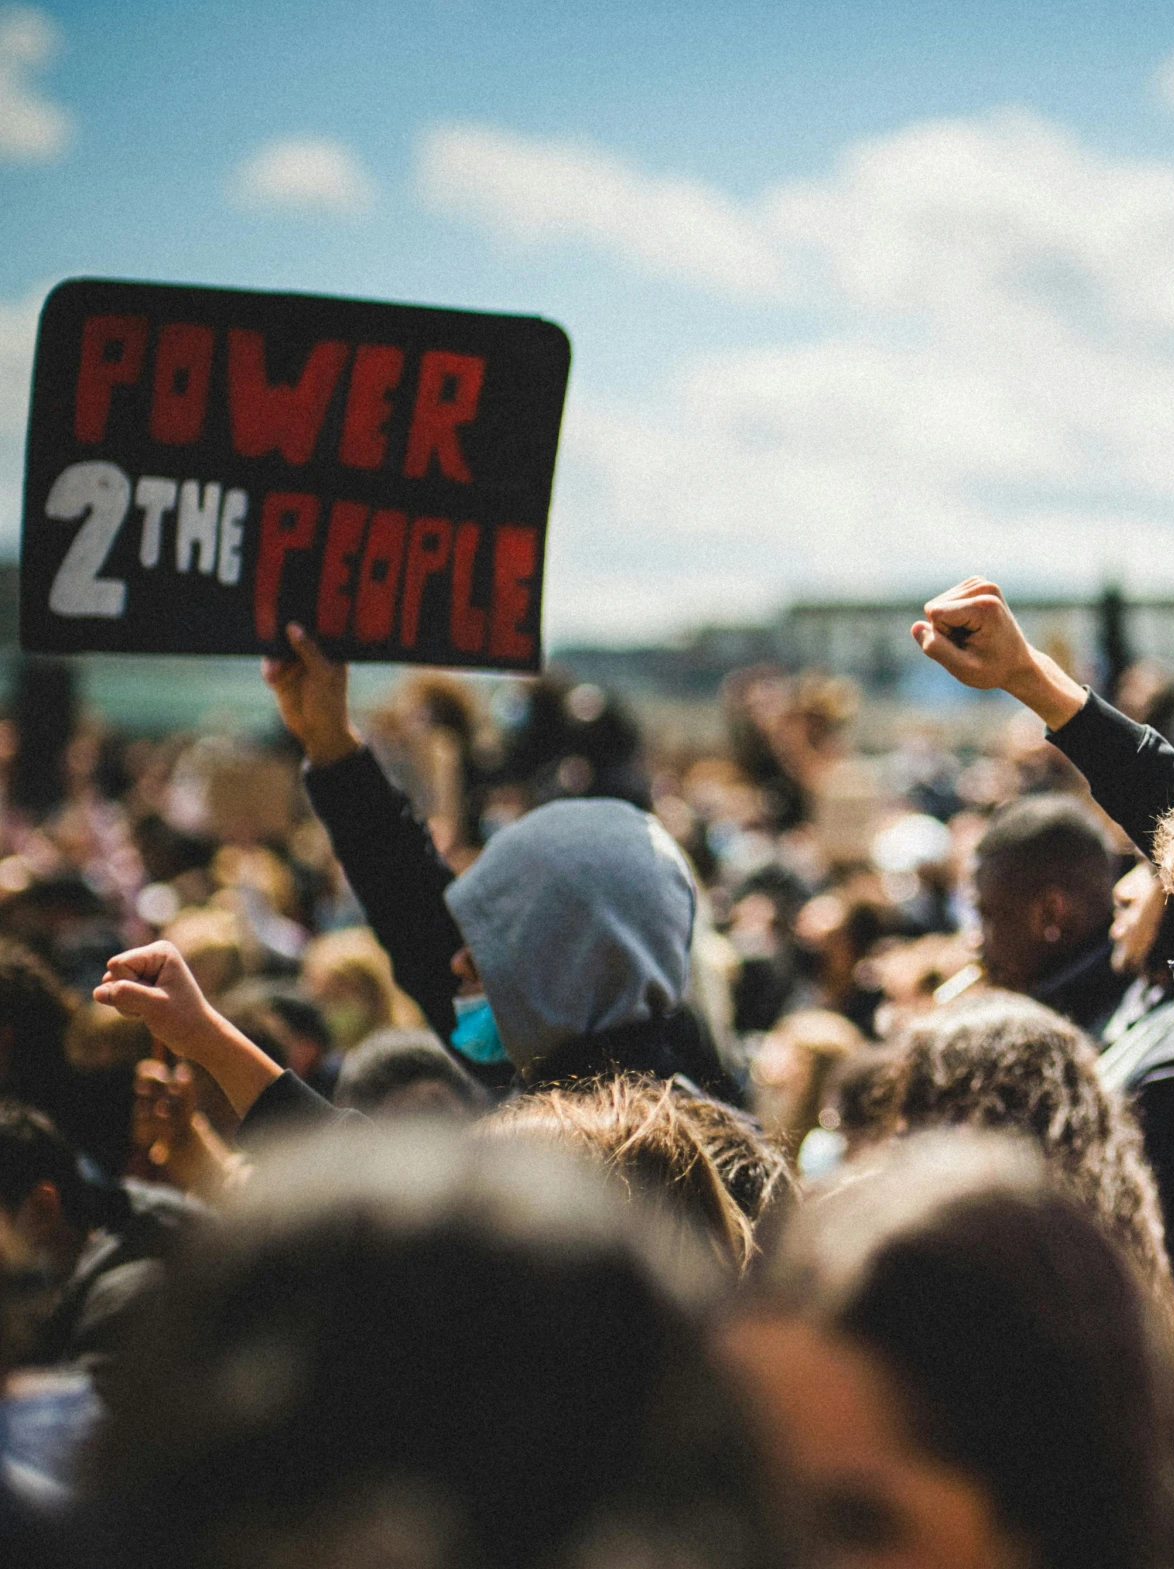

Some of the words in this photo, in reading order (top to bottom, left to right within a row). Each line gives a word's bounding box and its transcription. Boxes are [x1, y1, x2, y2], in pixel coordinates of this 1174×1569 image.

[75, 314, 486, 483] POWER
[45, 460, 131, 619] 2
[135, 476, 248, 585] THE
[253, 492, 537, 658] PEOPLE
